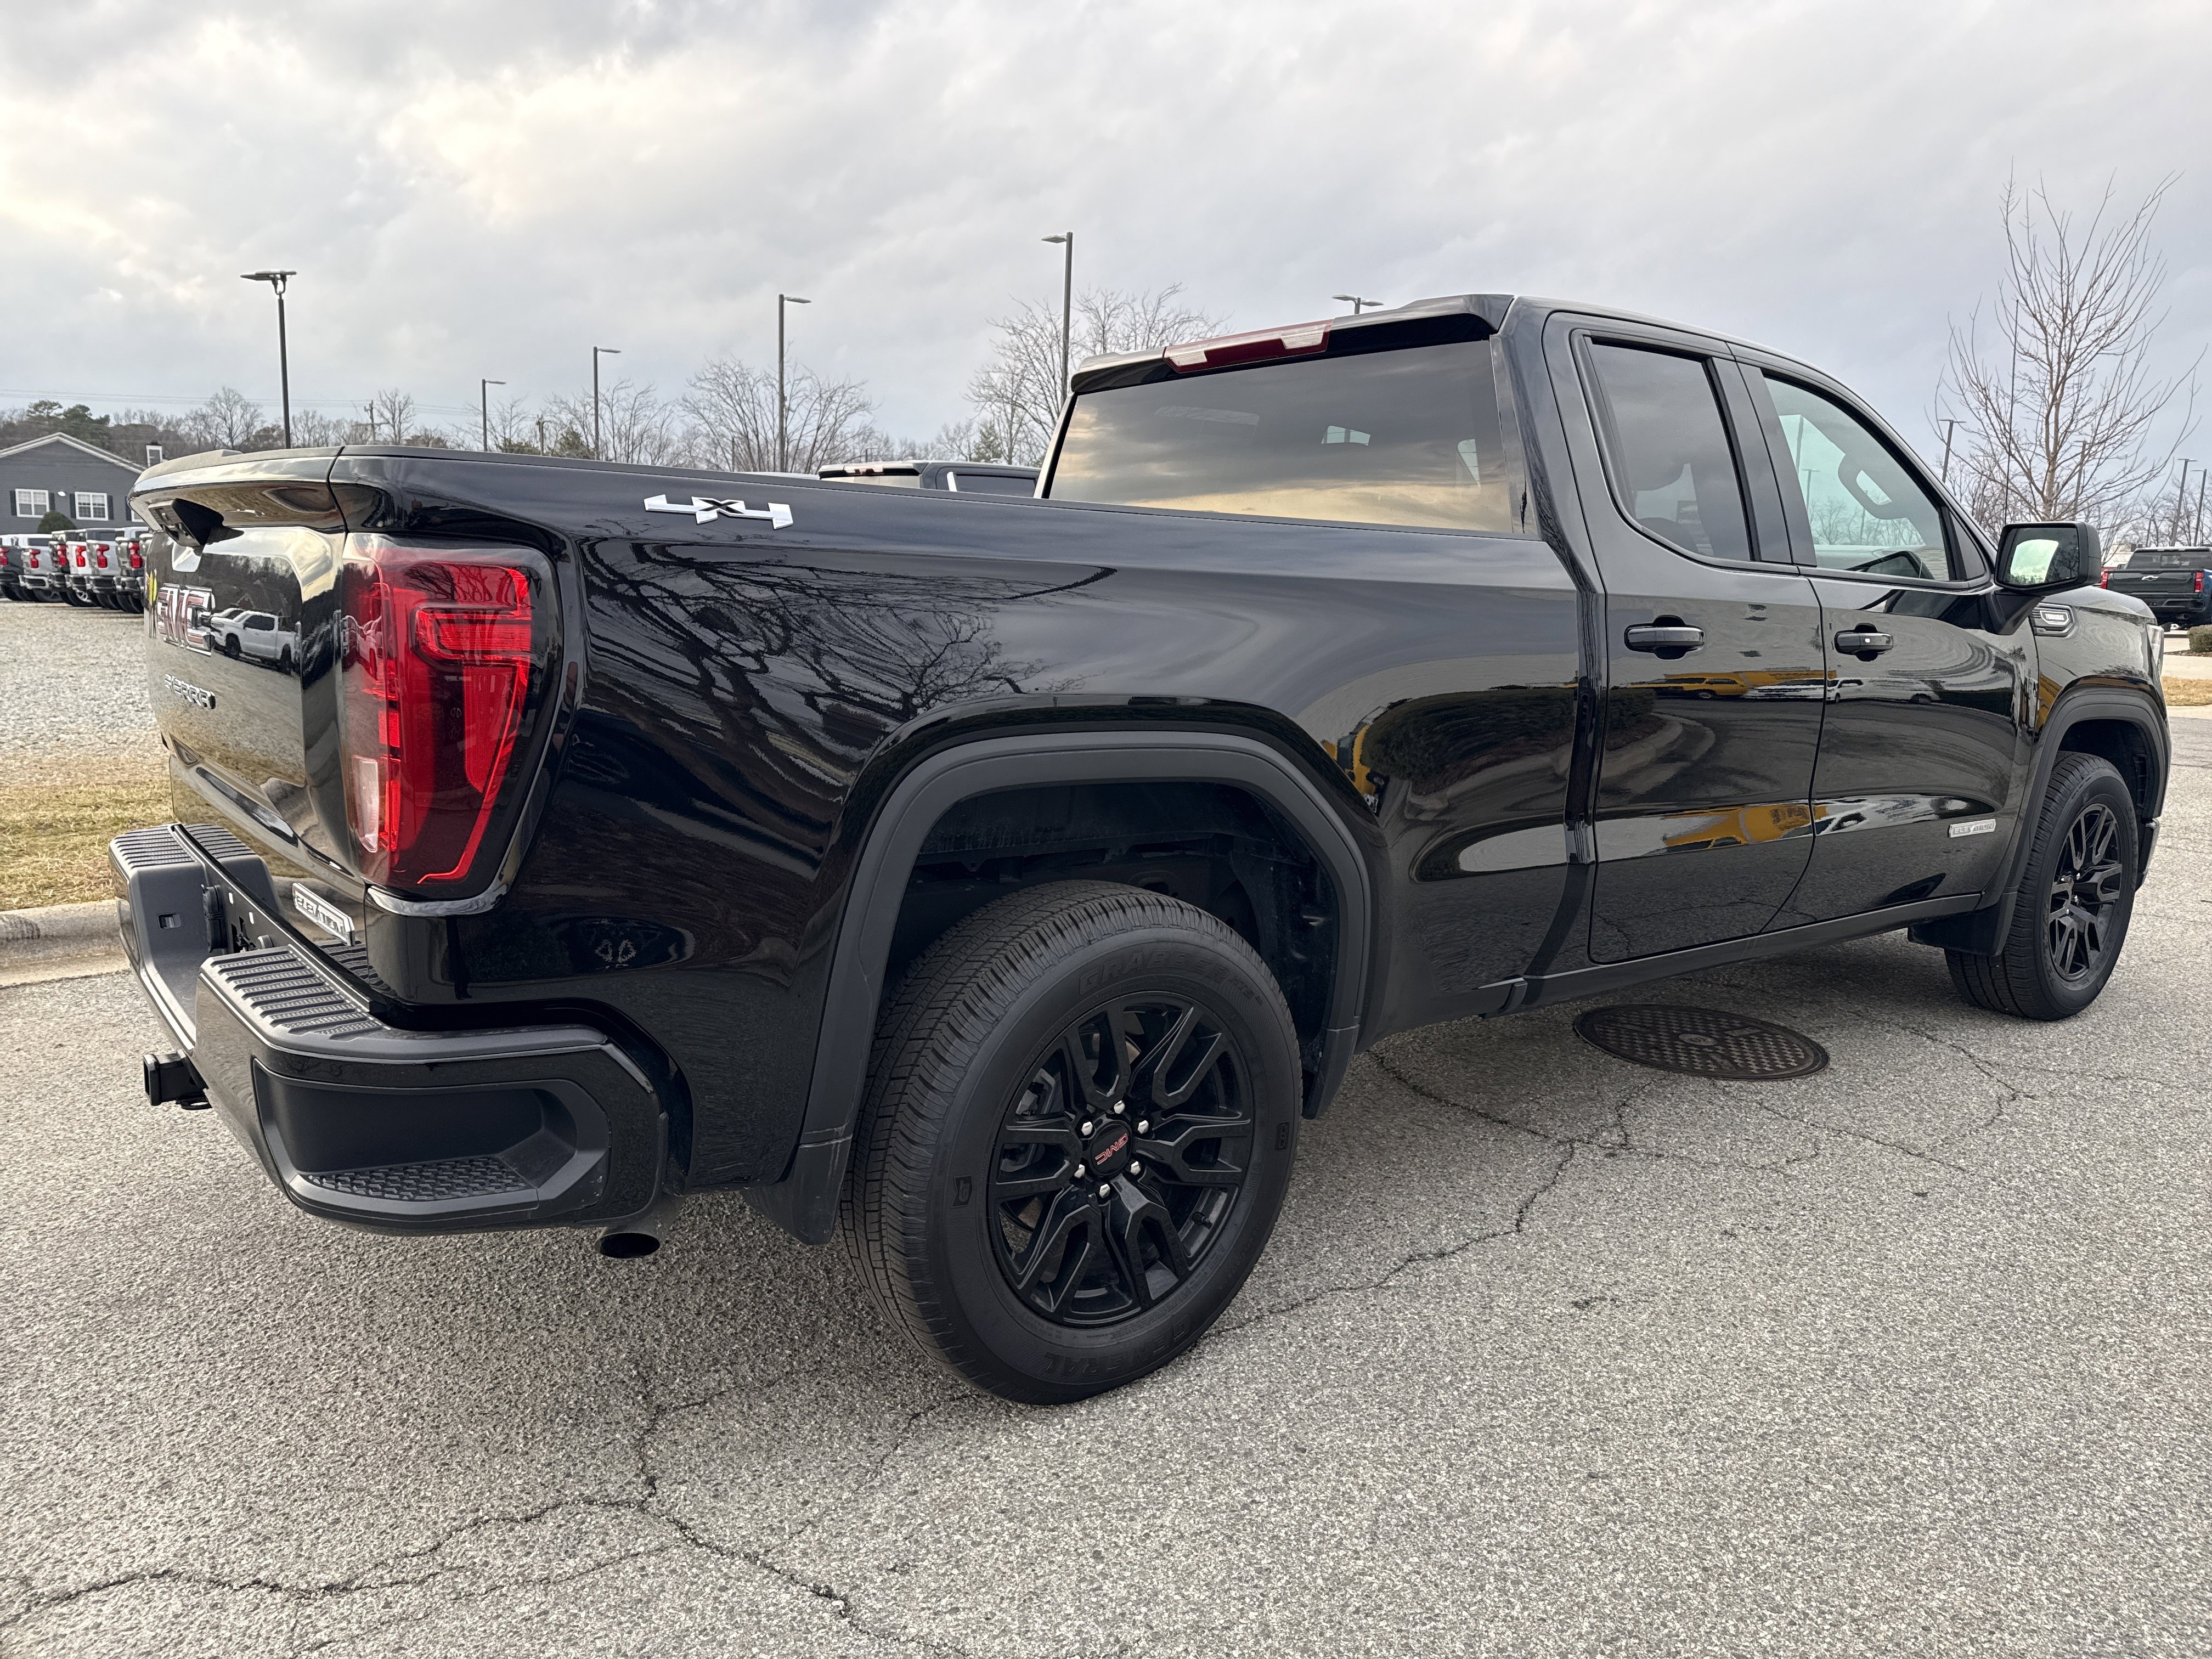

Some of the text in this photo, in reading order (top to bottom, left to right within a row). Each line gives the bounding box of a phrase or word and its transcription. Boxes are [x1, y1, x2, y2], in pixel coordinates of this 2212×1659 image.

[157, 583, 215, 656] GMC
[165, 674, 216, 709] SIERRA
[1953, 823, 1994, 834] ELEVATION
[1079, 950, 1229, 995] GRABBER
[1095, 1133, 1128, 1165] GMC
[1043, 1313, 1189, 1376] GENERAL
